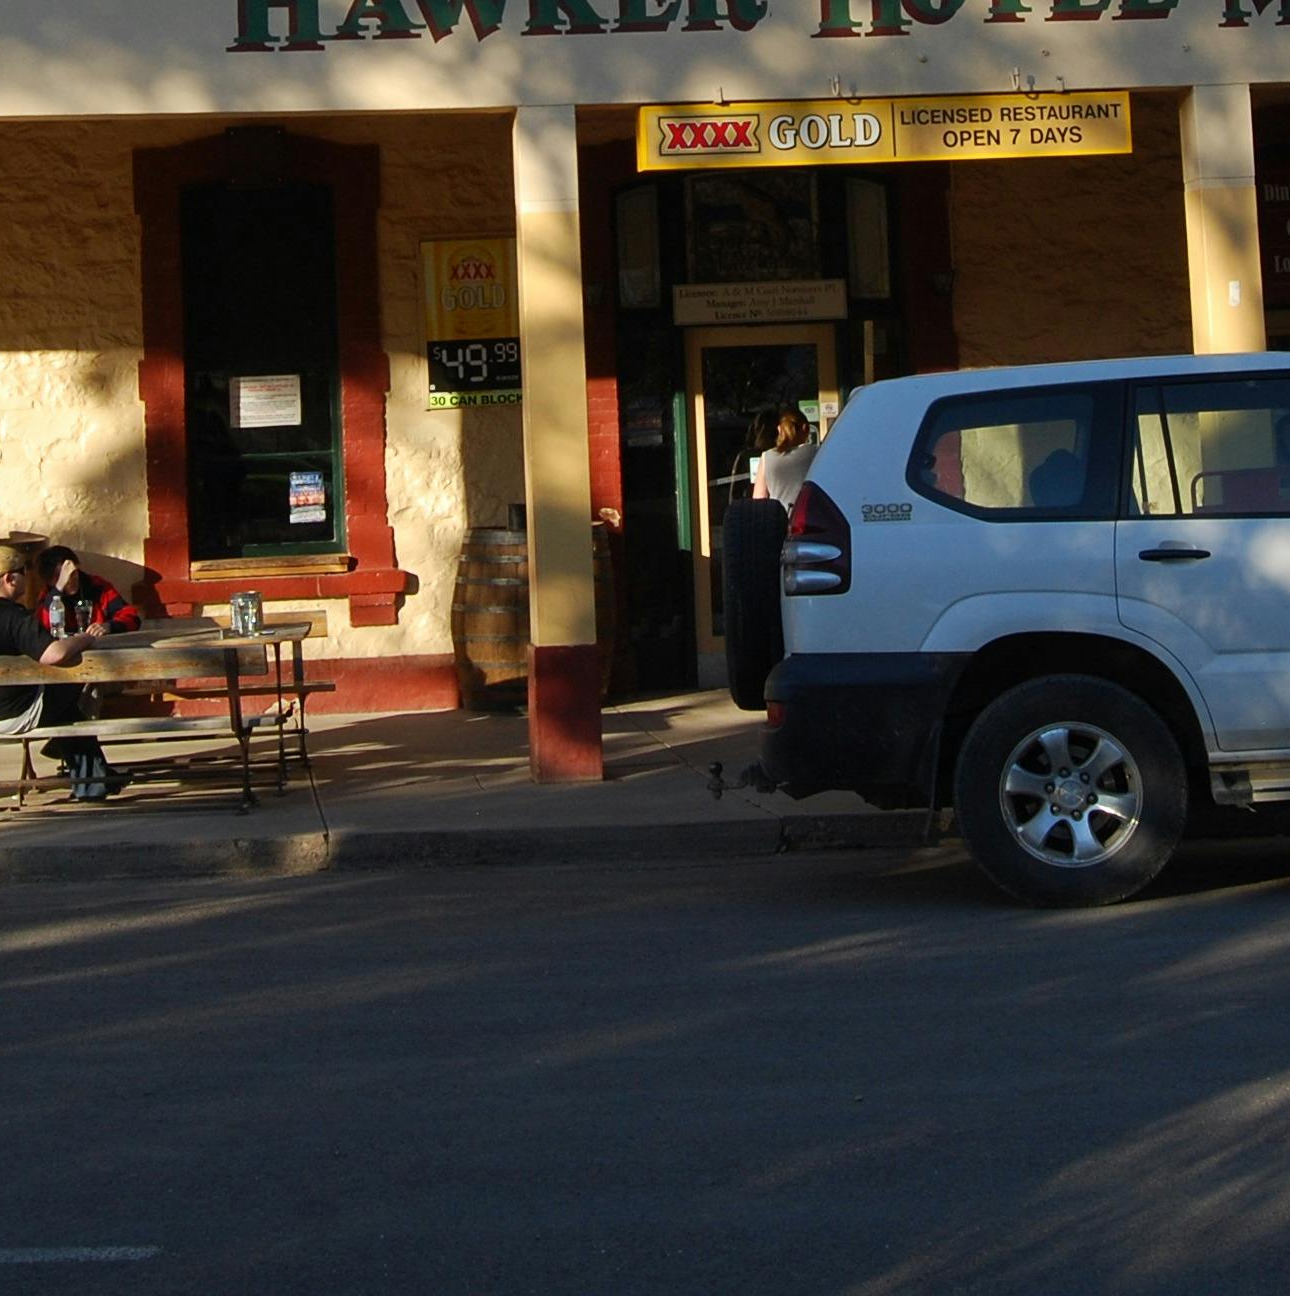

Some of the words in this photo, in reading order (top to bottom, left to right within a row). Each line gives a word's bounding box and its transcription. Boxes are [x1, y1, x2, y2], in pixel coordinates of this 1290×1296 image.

[900, 104, 994, 126] LICENSED
[999, 101, 1121, 124] RESTAURANT
[664, 119, 755, 150] XXXX
[768, 112, 882, 151] GOLD
[942, 128, 1001, 149] OPEN
[1009, 127, 1021, 146] 7
[1030, 124, 1084, 146] DAYS
[448, 263, 496, 281] XXXX
[441, 284, 506, 312] GOLD
[433, 342, 519, 383] $49.99
[431, 395, 447, 407] 30
[449, 394, 478, 406] CAN
[861, 503, 913, 513] 3000
